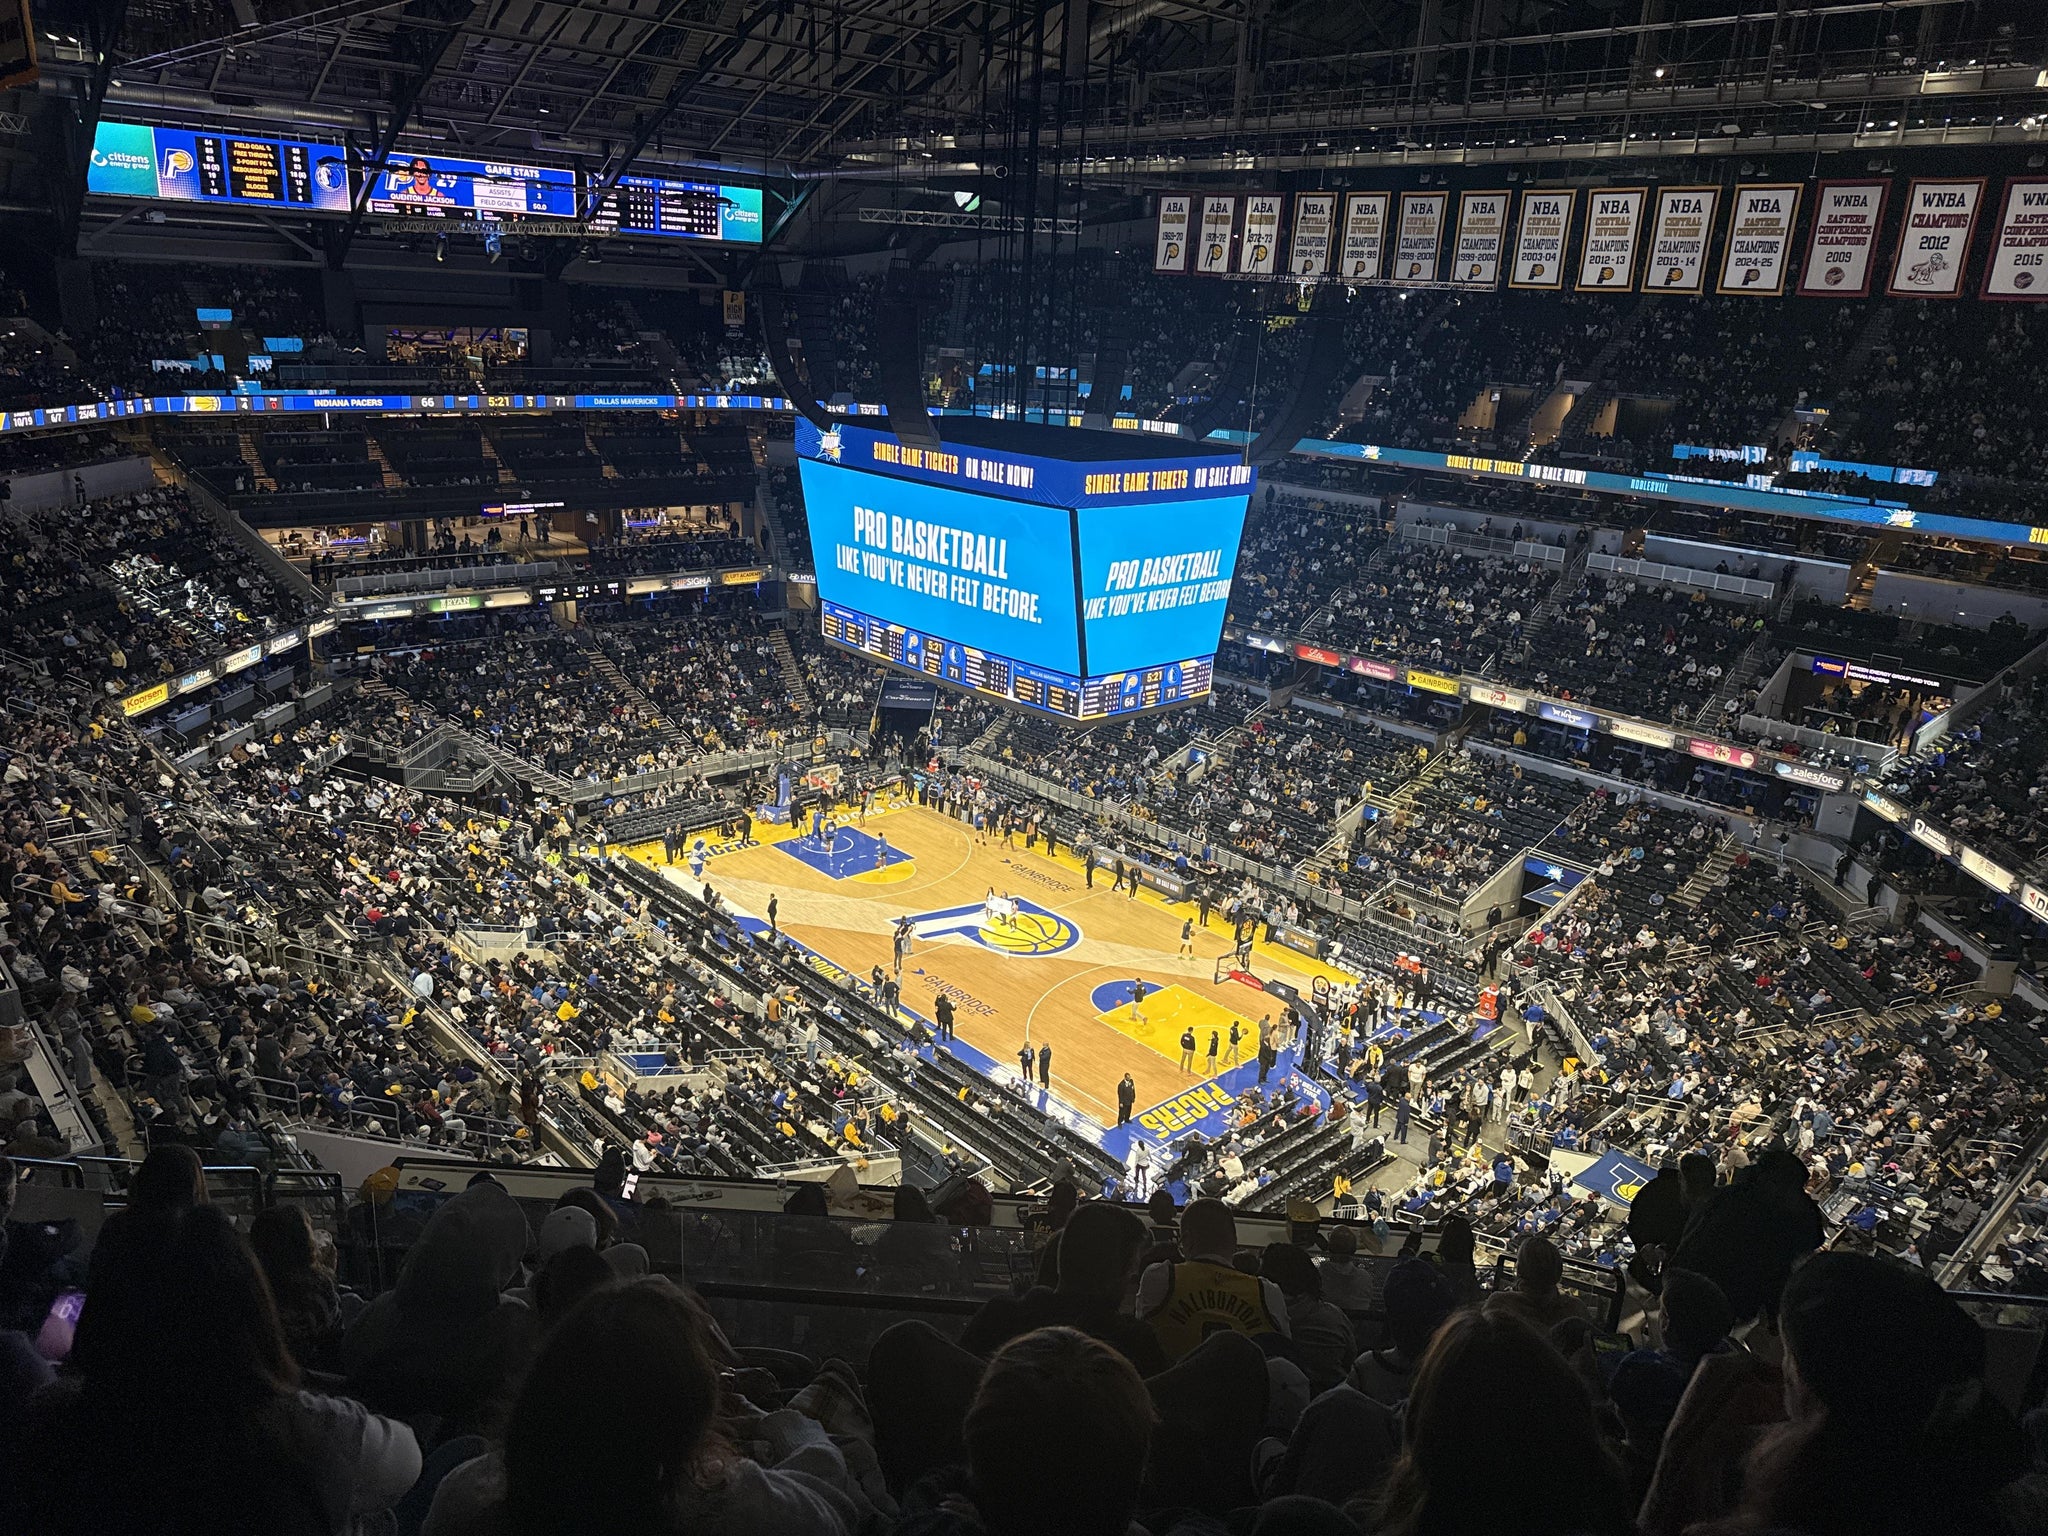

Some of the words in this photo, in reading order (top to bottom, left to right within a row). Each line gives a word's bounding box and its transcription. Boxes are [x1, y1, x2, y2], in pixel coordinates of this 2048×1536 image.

[108, 152, 149, 164] citizens
[109, 161, 131, 169] energy
[233, 166, 263, 174] REBOUNDS
[485, 165, 512, 175] GAME
[514, 168, 540, 178] STATS
[241, 190, 274, 199] TURNOVERS
[390, 193, 423, 202] QUENTON
[424, 195, 455, 204] JACKSON
[1922, 193, 1966, 207] WNBA
[1669, 199, 1702, 213] NBA
[1748, 199, 1781, 213] NBA
[1833, 195, 1868, 207] WNBA
[1166, 202, 1184, 213] ABA
[1209, 203, 1228, 213] ABA
[1253, 203, 1273, 213] ABA
[1305, 204, 1325, 215] NBA
[1356, 204, 1377, 214] NBA
[1410, 203, 1434, 214] NBA
[1471, 202, 1496, 214] NBA
[1532, 202, 1560, 215] NBA
[1599, 200, 1630, 214] NBA
[735, 210, 758, 218] citizens
[1827, 215, 1867, 224] EASTERN
[1527, 217, 1561, 226] CENTRAL
[1595, 217, 1631, 226] CENTRAL
[1665, 217, 1702, 227] CENTRAL
[1744, 218, 1781, 226] EASTERN
[1911, 214, 1969, 228] CHAMPIONS
[1526, 227, 1560, 236] DIVISION
[1594, 227, 1629, 236] DIVISION
[1664, 228, 1700, 238] DIVISION
[1736, 228, 1785, 236] CONFERENCE
[1818, 226, 1871, 235] CONFERENCE
[1296, 236, 1326, 247] CHAMPIONS
[1347, 237, 1379, 247] CHAMPIONS
[1401, 238, 1435, 249] CHAMPIONS
[1461, 238, 1496, 250] CHAMPIONS
[1522, 239, 1558, 250] CHAMPIONS
[1590, 240, 1629, 252] CHAMPIONS
[1658, 241, 1700, 253] CHAMPIONS
[1734, 241, 1779, 253] CHAMPIONS
[1818, 237, 1867, 246] CHAMPIONS
[1919, 236, 1950, 250] 2012
[1295, 249, 1325, 258] 1994-95
[1346, 250, 1377, 259] 1998-99
[1399, 252, 1435, 260] 1999-2000
[1458, 253, 1496, 261] 1999-2000
[1521, 253, 1556, 262] 2003-04
[1826, 252, 1852, 262] 2009
[1735, 258, 1773, 266] 2024-25
[2014, 254, 2044, 266] 2015
[727, 304, 742, 313] HIGH
[421, 398, 434, 407] 66
[488, 397, 510, 406] 5:21
[555, 397, 565, 406] 71
[1112, 418, 1138, 429] TICKETS
[874, 442, 899, 464] SINGLE
[901, 446, 922, 469] GAME
[924, 451, 958, 474] TICKETS
[966, 457, 978, 479] ON
[981, 460, 1004, 484] SALE
[1007, 463, 1034, 488] NOW!
[1446, 455, 1471, 469] SINGLE
[1472, 457, 1493, 472] GAME
[1493, 460, 1524, 475] TICKETS
[1529, 465, 1540, 479] ON
[1542, 466, 1562, 482] SALE
[1563, 468, 1586, 484] NOW!
[1085, 474, 1121, 494] SINGLE
[1123, 472, 1150, 493] GAME
[1152, 470, 1188, 491] TICKETS
[1194, 468, 1208, 488] ON
[1208, 466, 1228, 488] SALE
[1230, 465, 1251, 485] NOW!
[854, 506, 887, 550] PRO
[892, 515, 1008, 579] BASKETBALL
[1105, 560, 1140, 592] PRO
[1139, 549, 1222, 588] BASKETBALL
[670, 577, 712, 587] SHIPSIGMA
[837, 544, 859, 575] LIKE
[862, 550, 904, 588] YOU'VE
[907, 563, 948, 600] NEVER
[951, 574, 980, 608] FELT
[982, 582, 1042, 624] BEFORE.
[447, 597, 469, 606] RYAN
[1084, 597, 1107, 620] LIKE
[1108, 592, 1147, 617] YOU'VE
[1146, 588, 1179, 611] NEVER
[1179, 584, 1200, 606] FELT
[271, 638, 286, 649] ksm
[928, 641, 942, 653] 5:21
[227, 652, 250, 667] SECTION
[908, 654, 916, 664] 66
[1307, 649, 1326, 662] Lilly
[950, 668, 958, 678] 71
[1147, 670, 1163, 682] 5:21
[1848, 672, 1868, 680] INDIANA
[1868, 675, 1890, 684] PACERS
[1849, 665, 1868, 673] CITIZEN
[1869, 668, 1891, 678] ENERGY
[1892, 672, 1911, 681] GROUP
[1924, 679, 1940, 688] YOUR
[1417, 677, 1456, 692] GAINBRIDGE
[126, 688, 162, 708] Koorsen
[1167, 688, 1176, 698] 71
[1124, 696, 1134, 707] 66
[1561, 710, 1583, 722] Kroger
[1793, 767, 1844, 787] salesforce
[889, 800, 917, 810] OIL
[1925, 826, 1948, 845] FANDUEL
[1010, 864, 1076, 892] GAINBRIDGE
[924, 976, 999, 1017] GAINBRIDGE
[1139, 1082, 1236, 1139] PACERS
[1169, 1290, 1262, 1330] HALIBURTON
